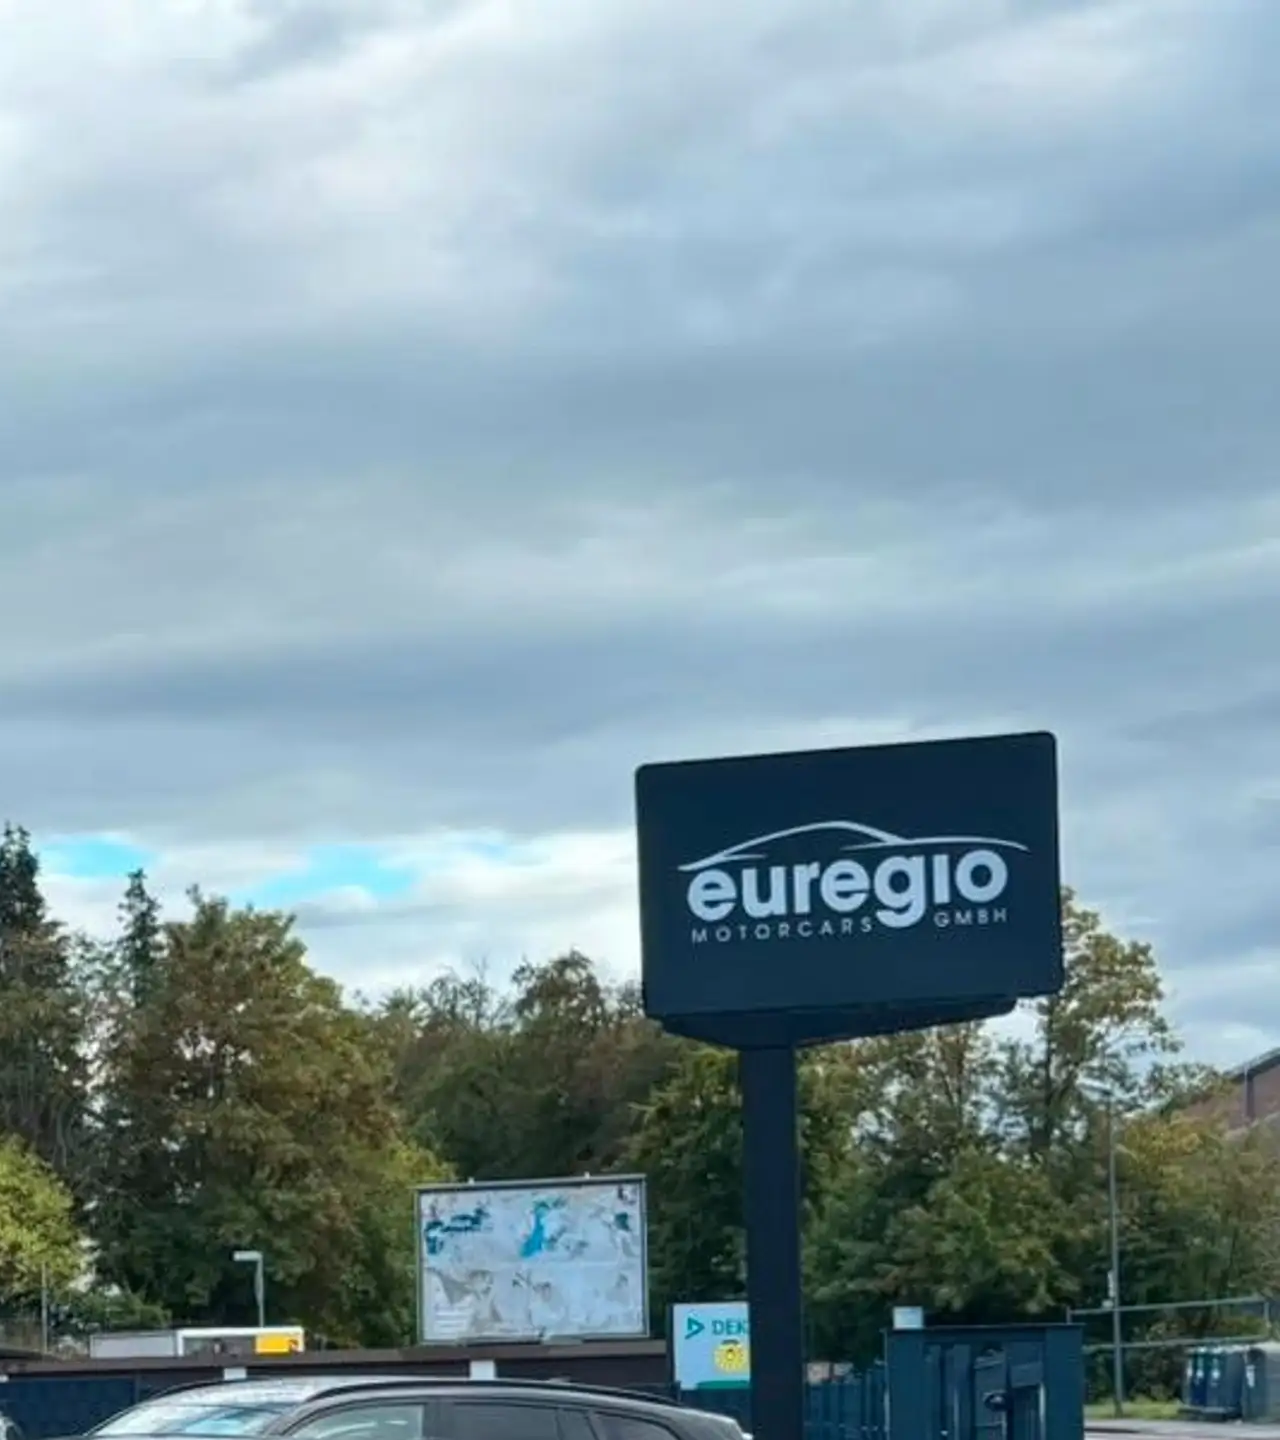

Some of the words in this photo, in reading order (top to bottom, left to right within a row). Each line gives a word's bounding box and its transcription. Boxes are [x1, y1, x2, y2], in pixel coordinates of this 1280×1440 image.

[686, 848, 1010, 929] euregio
[690, 916, 874, 944] MOTORCARS
[934, 907, 1009, 929] GMBH
